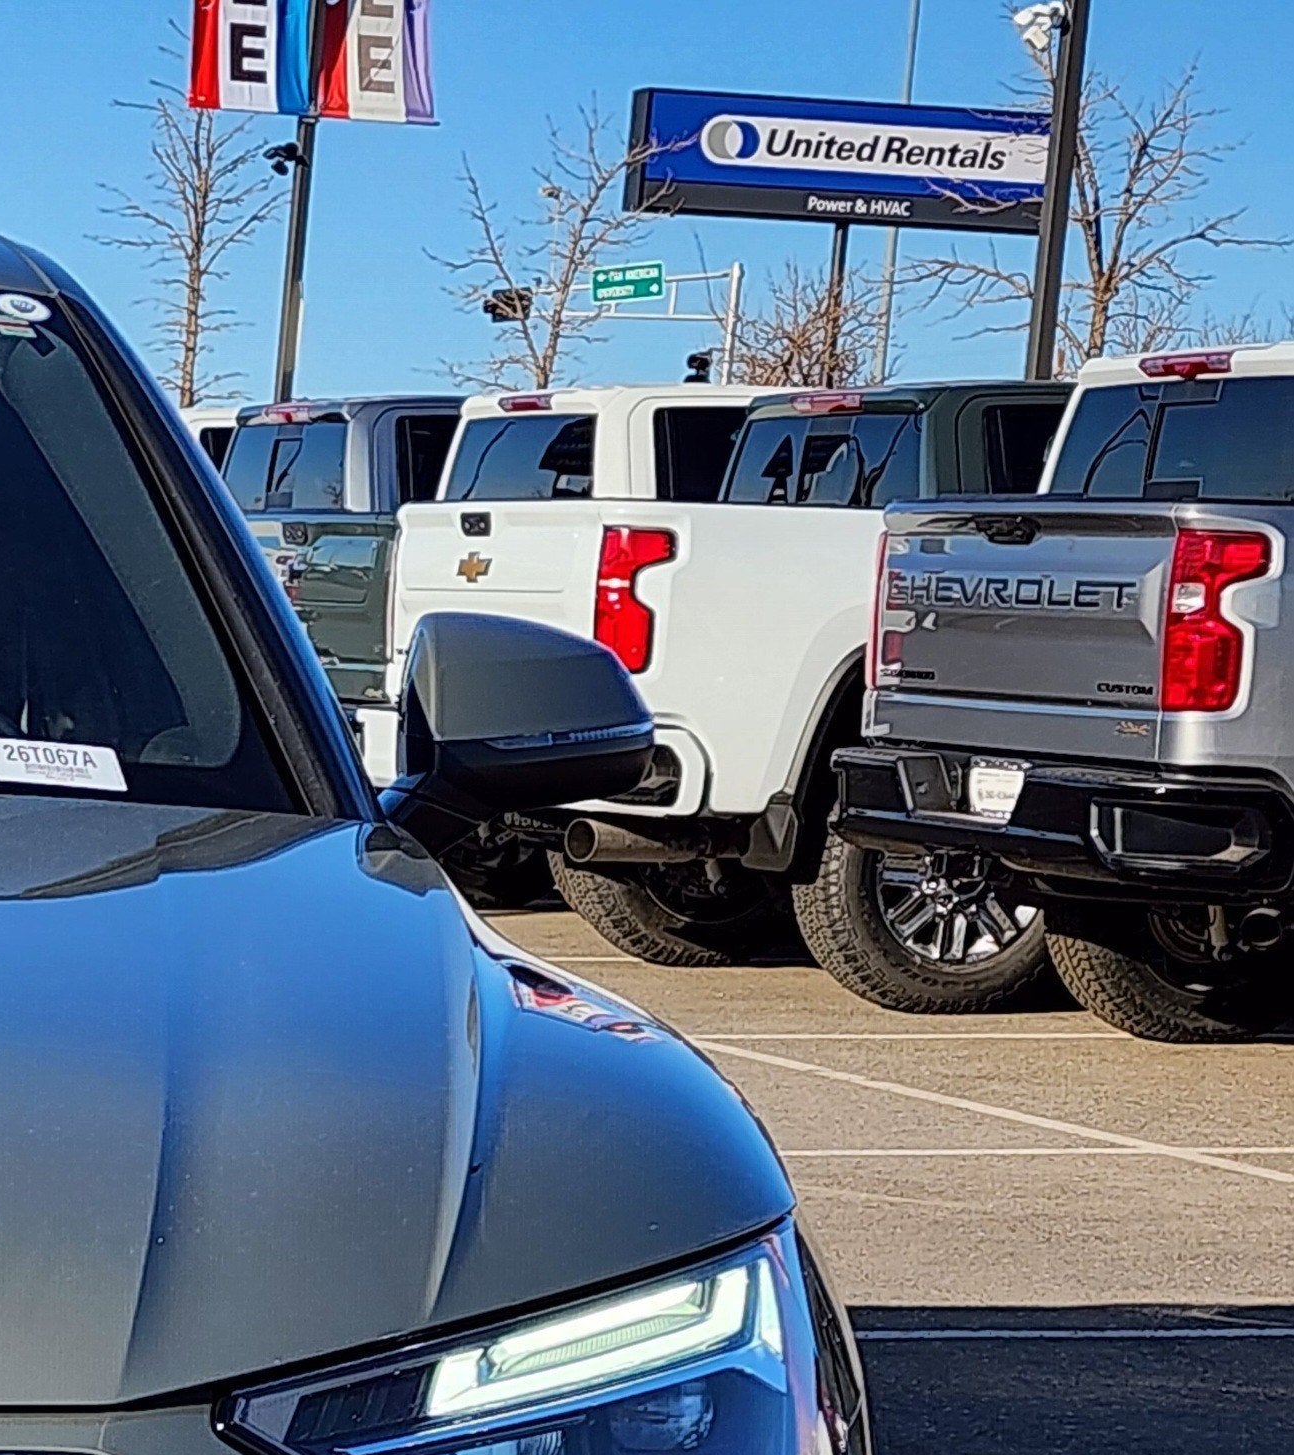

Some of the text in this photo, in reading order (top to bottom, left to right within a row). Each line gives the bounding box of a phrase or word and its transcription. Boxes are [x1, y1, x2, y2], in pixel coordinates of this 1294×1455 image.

[766, 128, 1007, 171] United Rentals
[807, 196, 911, 217] Power & HVAC
[888, 572, 1137, 610] CHEVROLET
[1097, 682, 1154, 696] CUSTOM
[3, 744, 97, 769] 26T067A
